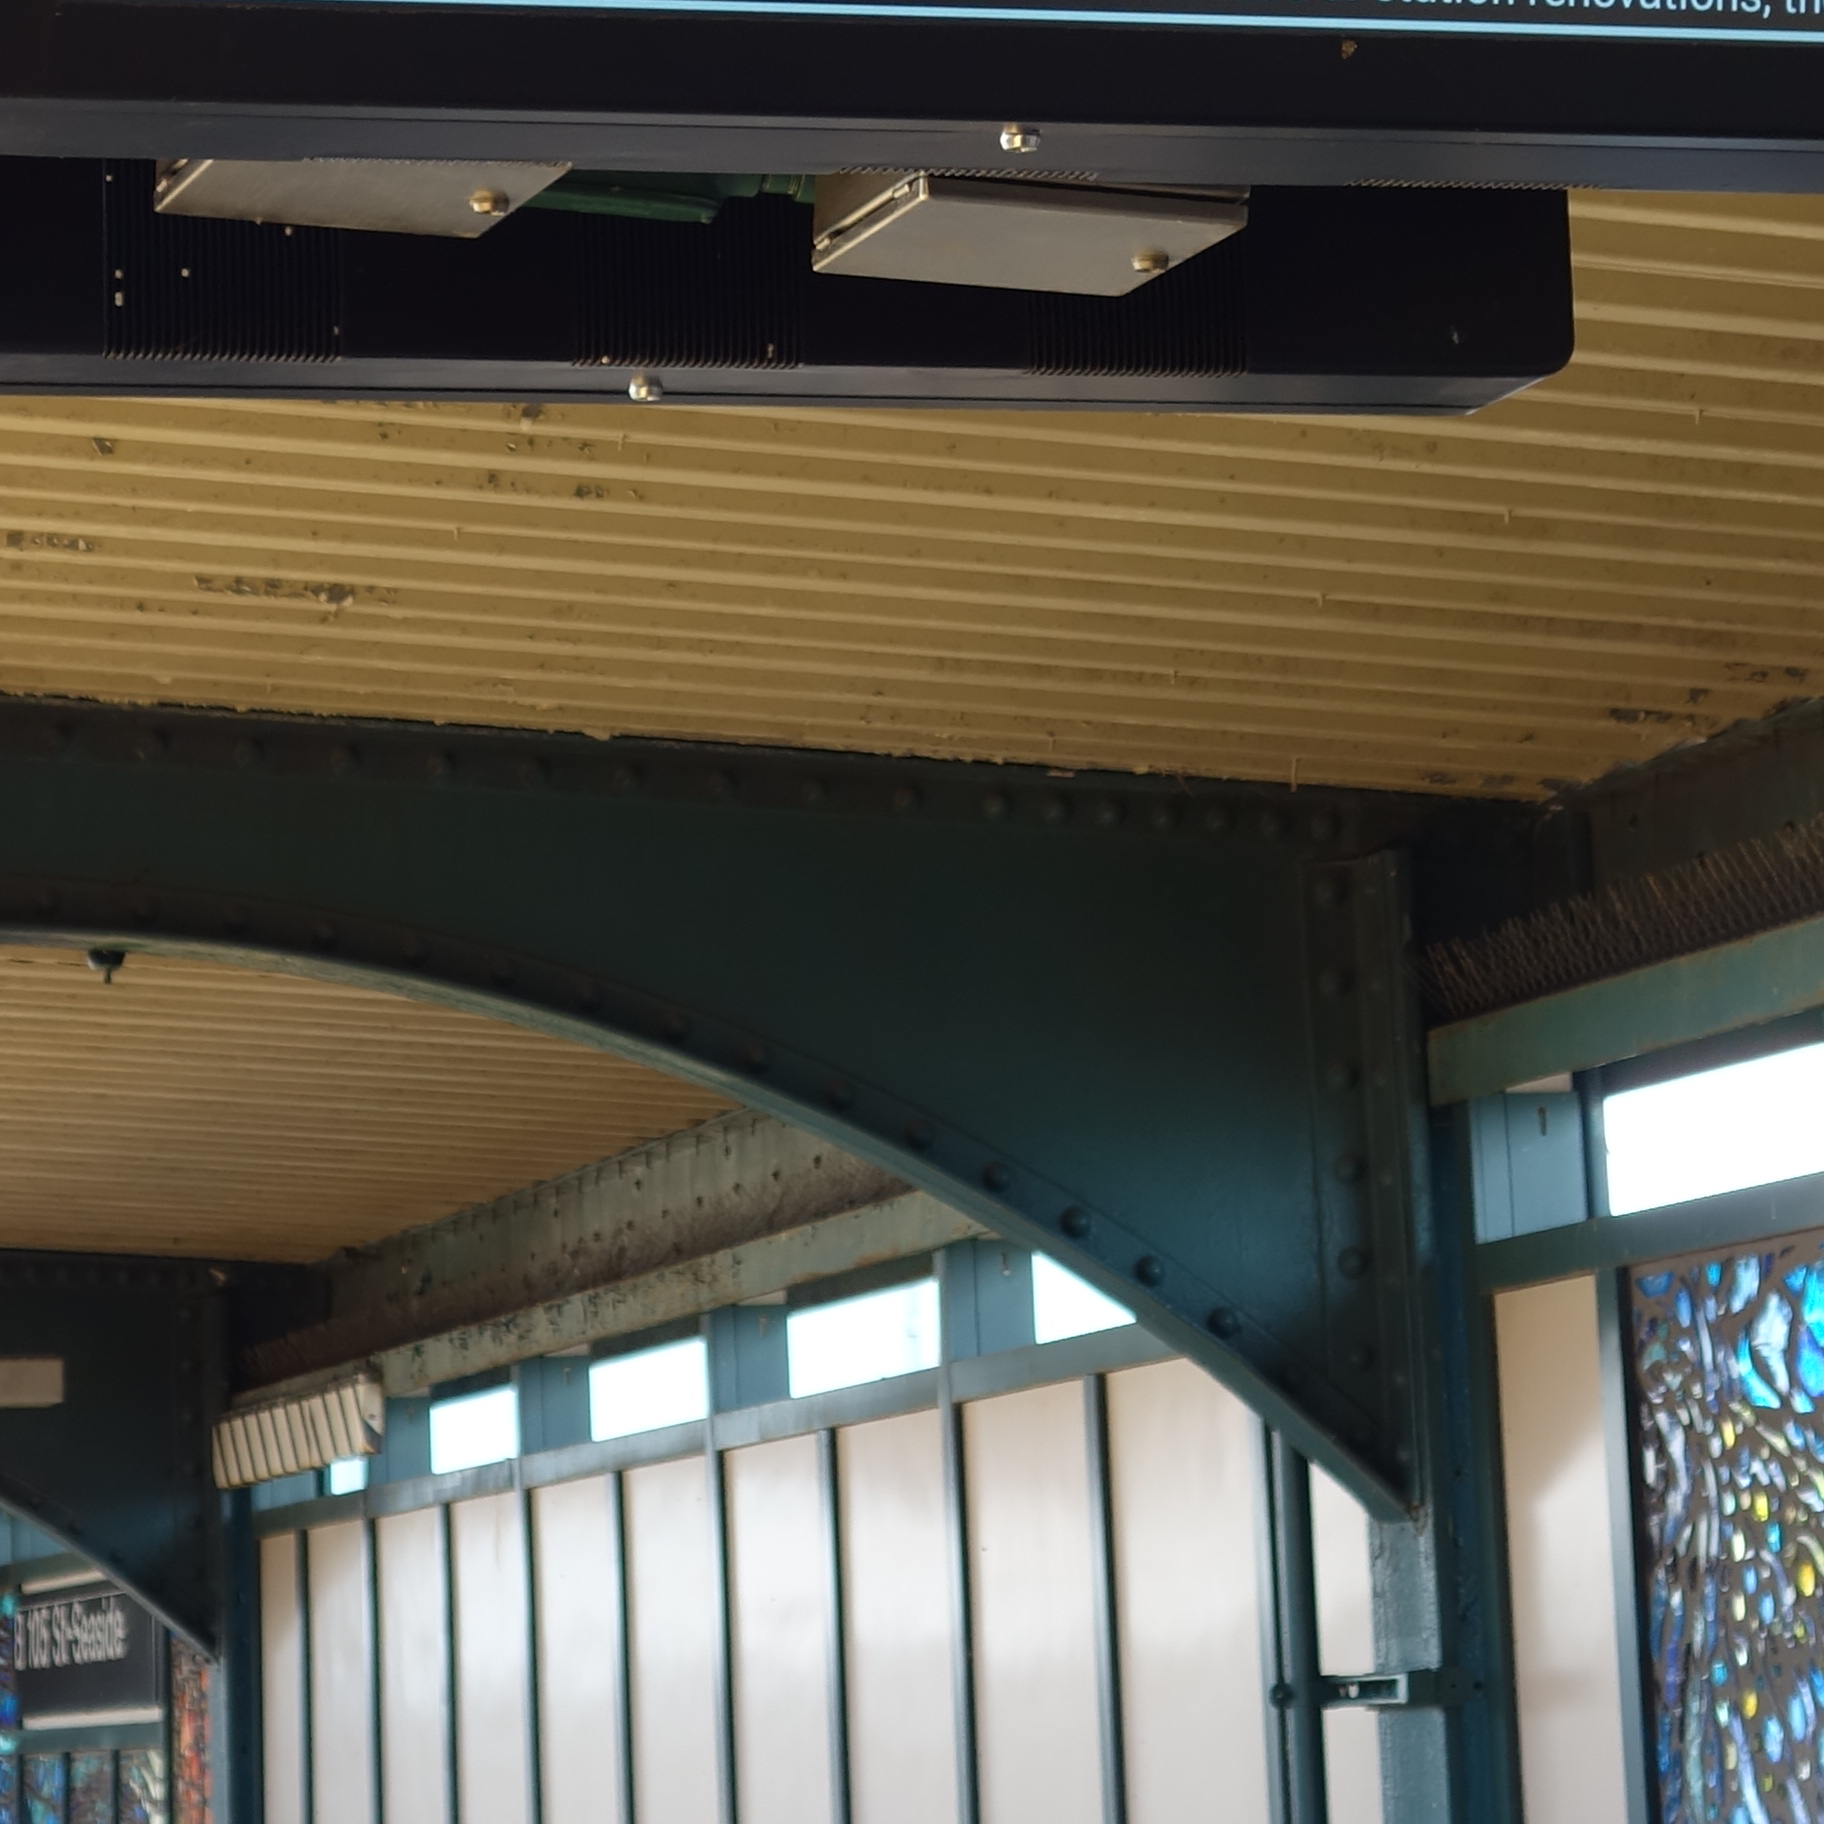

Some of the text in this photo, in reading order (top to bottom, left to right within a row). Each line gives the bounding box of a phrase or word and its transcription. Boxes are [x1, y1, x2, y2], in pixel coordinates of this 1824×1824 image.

[14, 1596, 127, 1671] B 105 St-Seaside
